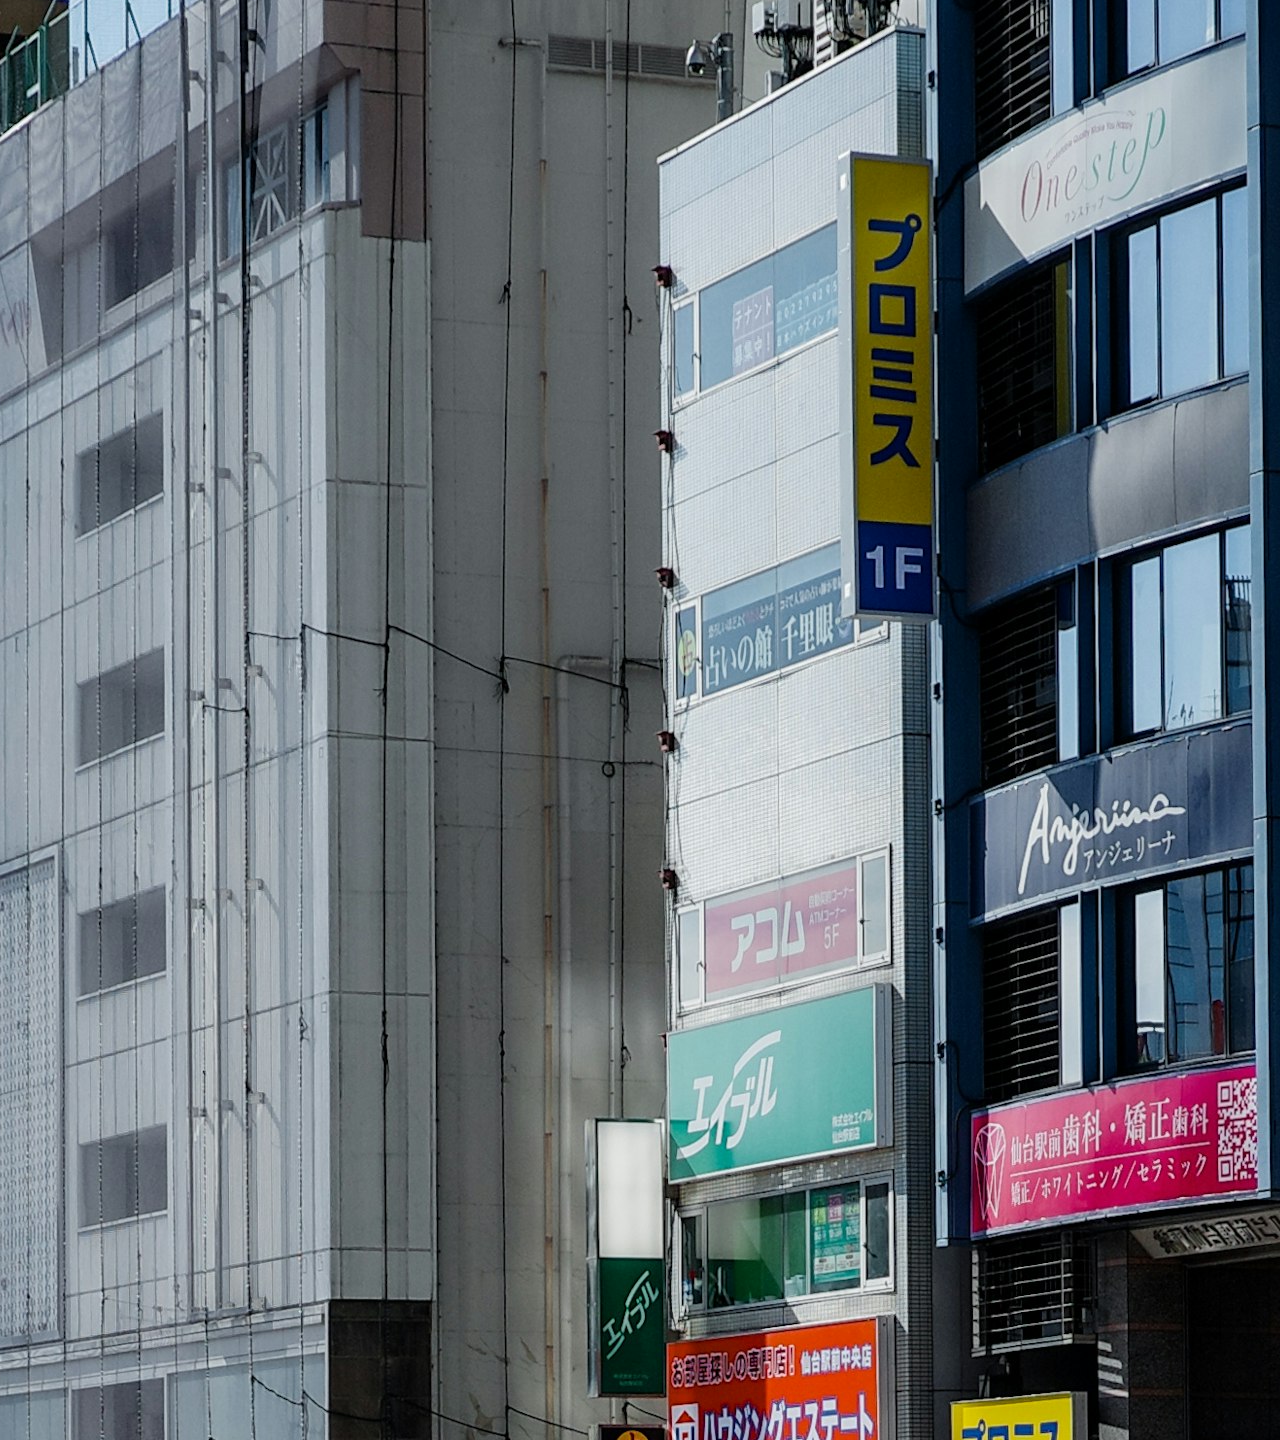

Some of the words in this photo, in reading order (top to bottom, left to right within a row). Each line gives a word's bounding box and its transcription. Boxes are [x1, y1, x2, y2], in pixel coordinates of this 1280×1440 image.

[867, 213, 923, 468] プロミス
[865, 544, 924, 590] 1F
[705, 624, 773, 690] 占いの館
[781, 602, 833, 660] 千里眼
[1082, 830, 1178, 873] アンジェリーナ
[731, 901, 807, 972] アコム
[823, 922, 840, 950] 5F
[675, 1029, 782, 1161] エイブル
[1010, 1097, 1210, 1167] 仙台駅前歯科・矯正歯科
[602, 1270, 660, 1360] エイブル
[801, 1344, 872, 1375] 仙台駅前中央店
